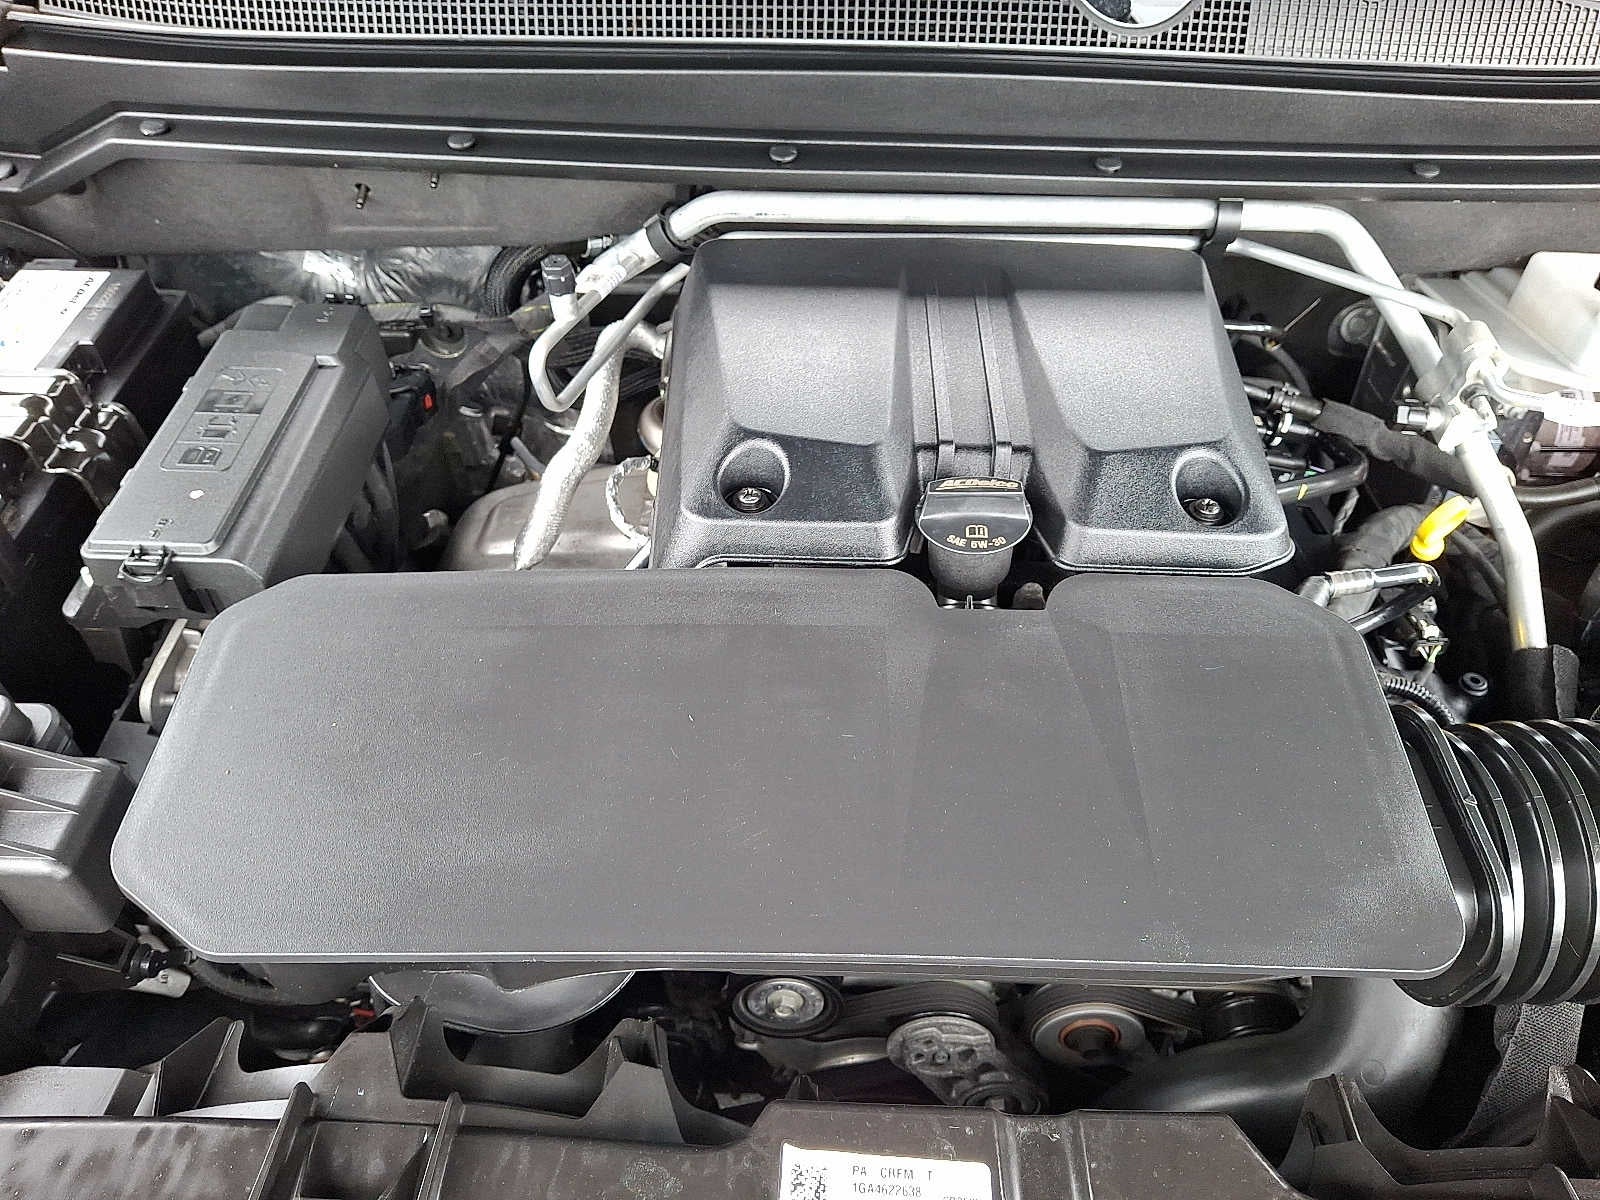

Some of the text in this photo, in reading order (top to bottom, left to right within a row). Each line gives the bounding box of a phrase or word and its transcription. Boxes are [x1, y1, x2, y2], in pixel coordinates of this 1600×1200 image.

[946, 534, 1007, 549] SAE 5W-30
[852, 1165, 867, 1177] PA
